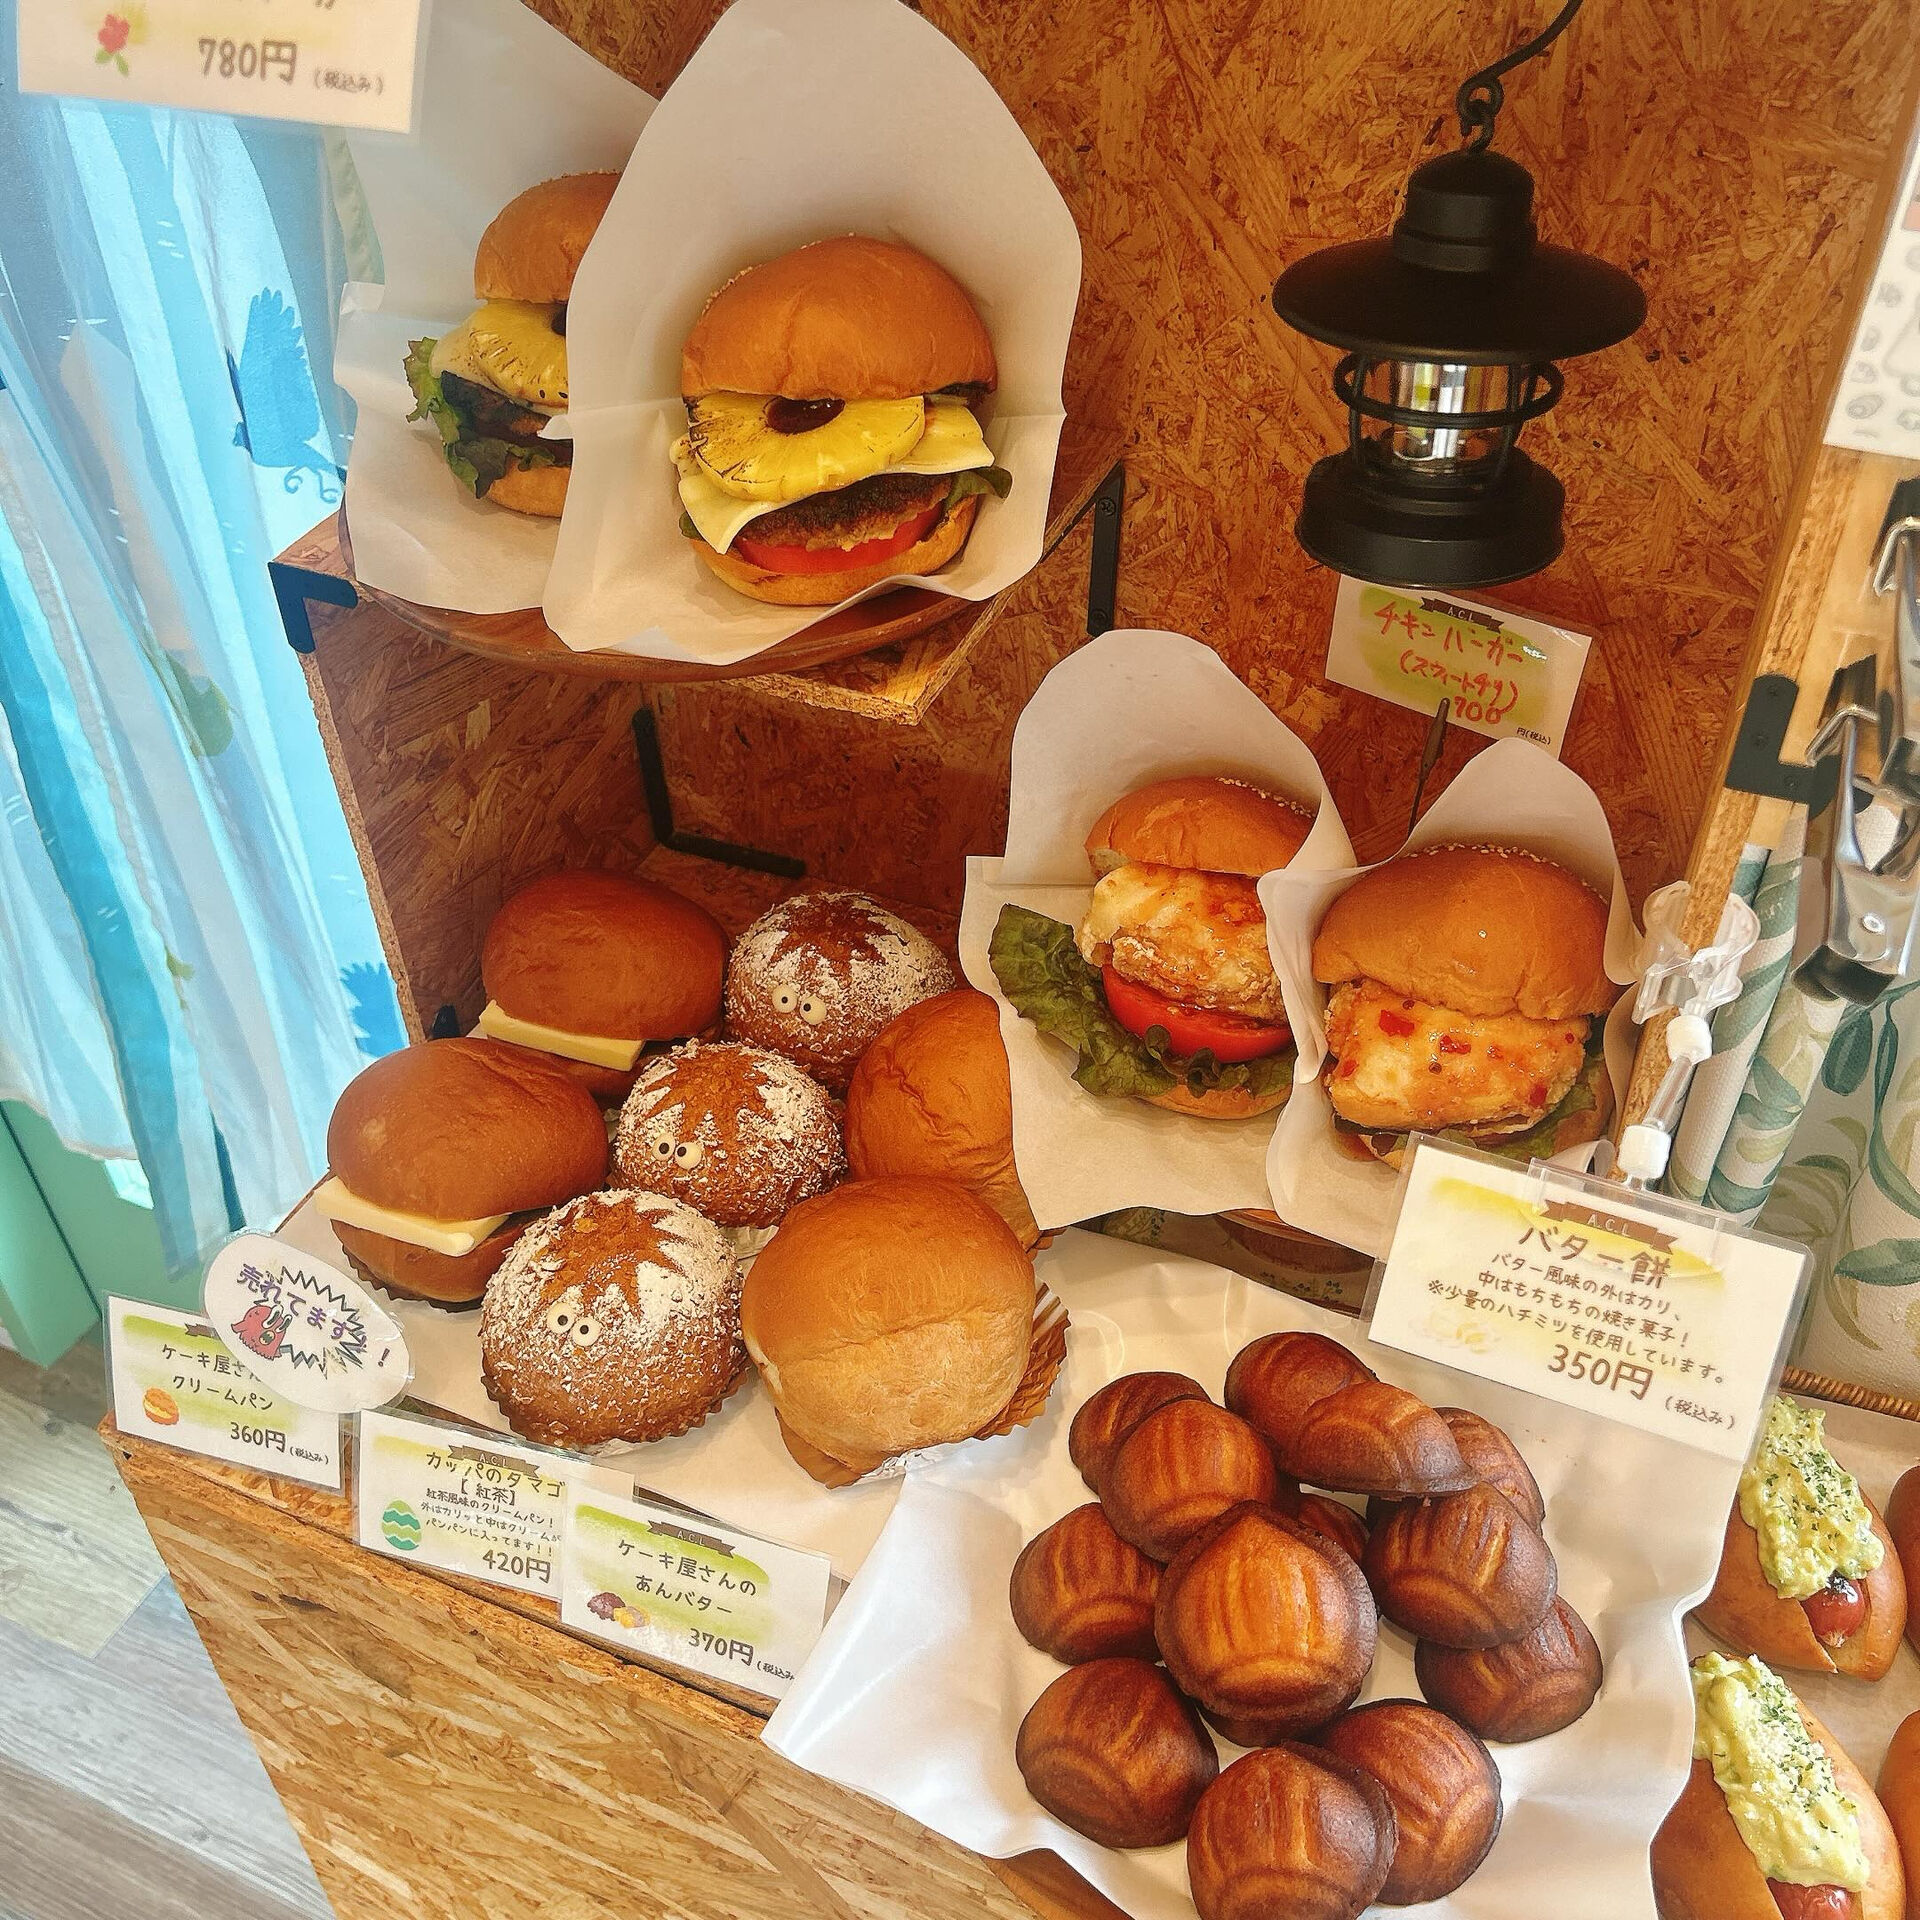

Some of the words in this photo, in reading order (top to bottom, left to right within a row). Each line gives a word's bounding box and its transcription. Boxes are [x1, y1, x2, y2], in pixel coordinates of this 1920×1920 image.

[199, 37, 298, 85] 780円
[1518, 1225, 1673, 1290] バター餅
[1478, 1270, 1691, 1348] 中はもちもちの焼き菓子！
[1491, 1253, 1683, 1322] バター風味の外はカリ、
[1427, 1278, 1726, 1385] ※少量のハチミツを使用しています。
[172, 1375, 274, 1411] クリームパン
[1547, 1343, 1653, 1401] 350円
[1664, 1395, 1737, 1430] （税込み）
[230, 1420, 287, 1453] 360円
[426, 1451, 566, 1498] カッパのタマゴ
[460, 1477, 516, 1506] 【紅茶】
[426, 1488, 554, 1529] 紅茶風味のクリームパン！
[482, 1549, 552, 1584] 420円
[618, 1539, 757, 1597] ケーキ屋さんの
[635, 1573, 734, 1615] あんバター
[687, 1626, 755, 1667] 370円
